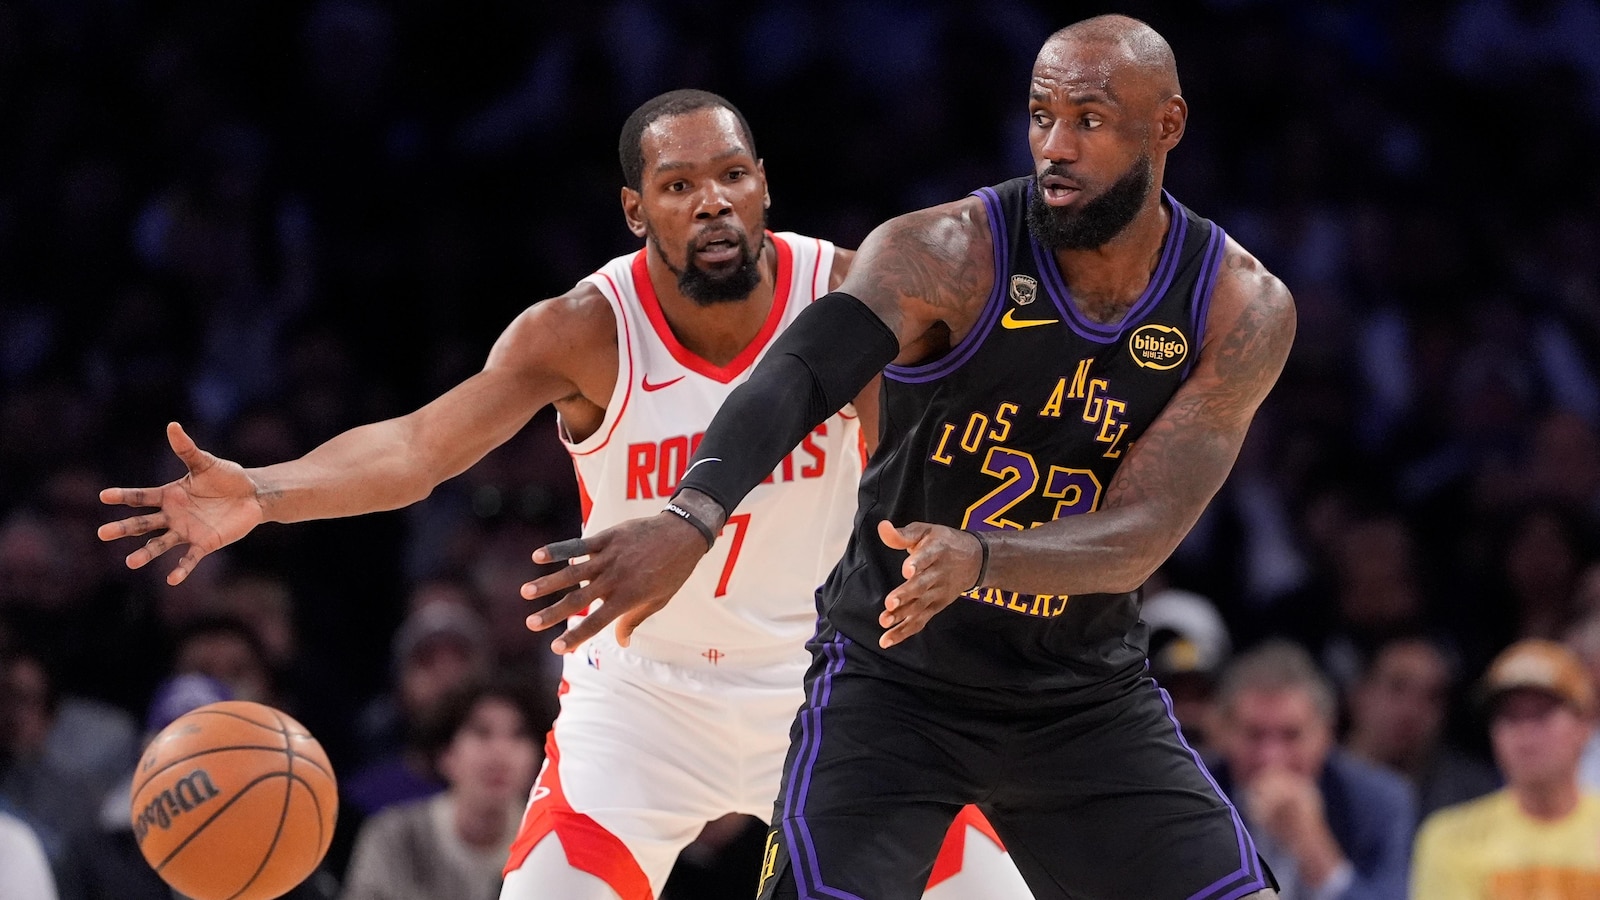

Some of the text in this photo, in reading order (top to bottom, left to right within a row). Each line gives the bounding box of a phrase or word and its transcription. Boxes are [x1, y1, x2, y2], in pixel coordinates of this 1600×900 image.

[1135, 334, 1184, 358] bibigo
[1142, 350, 1164, 360] 비비고
[929, 357, 1136, 467] LOS ANGEL
[960, 446, 1102, 532] 23
[714, 513, 752, 598] 7
